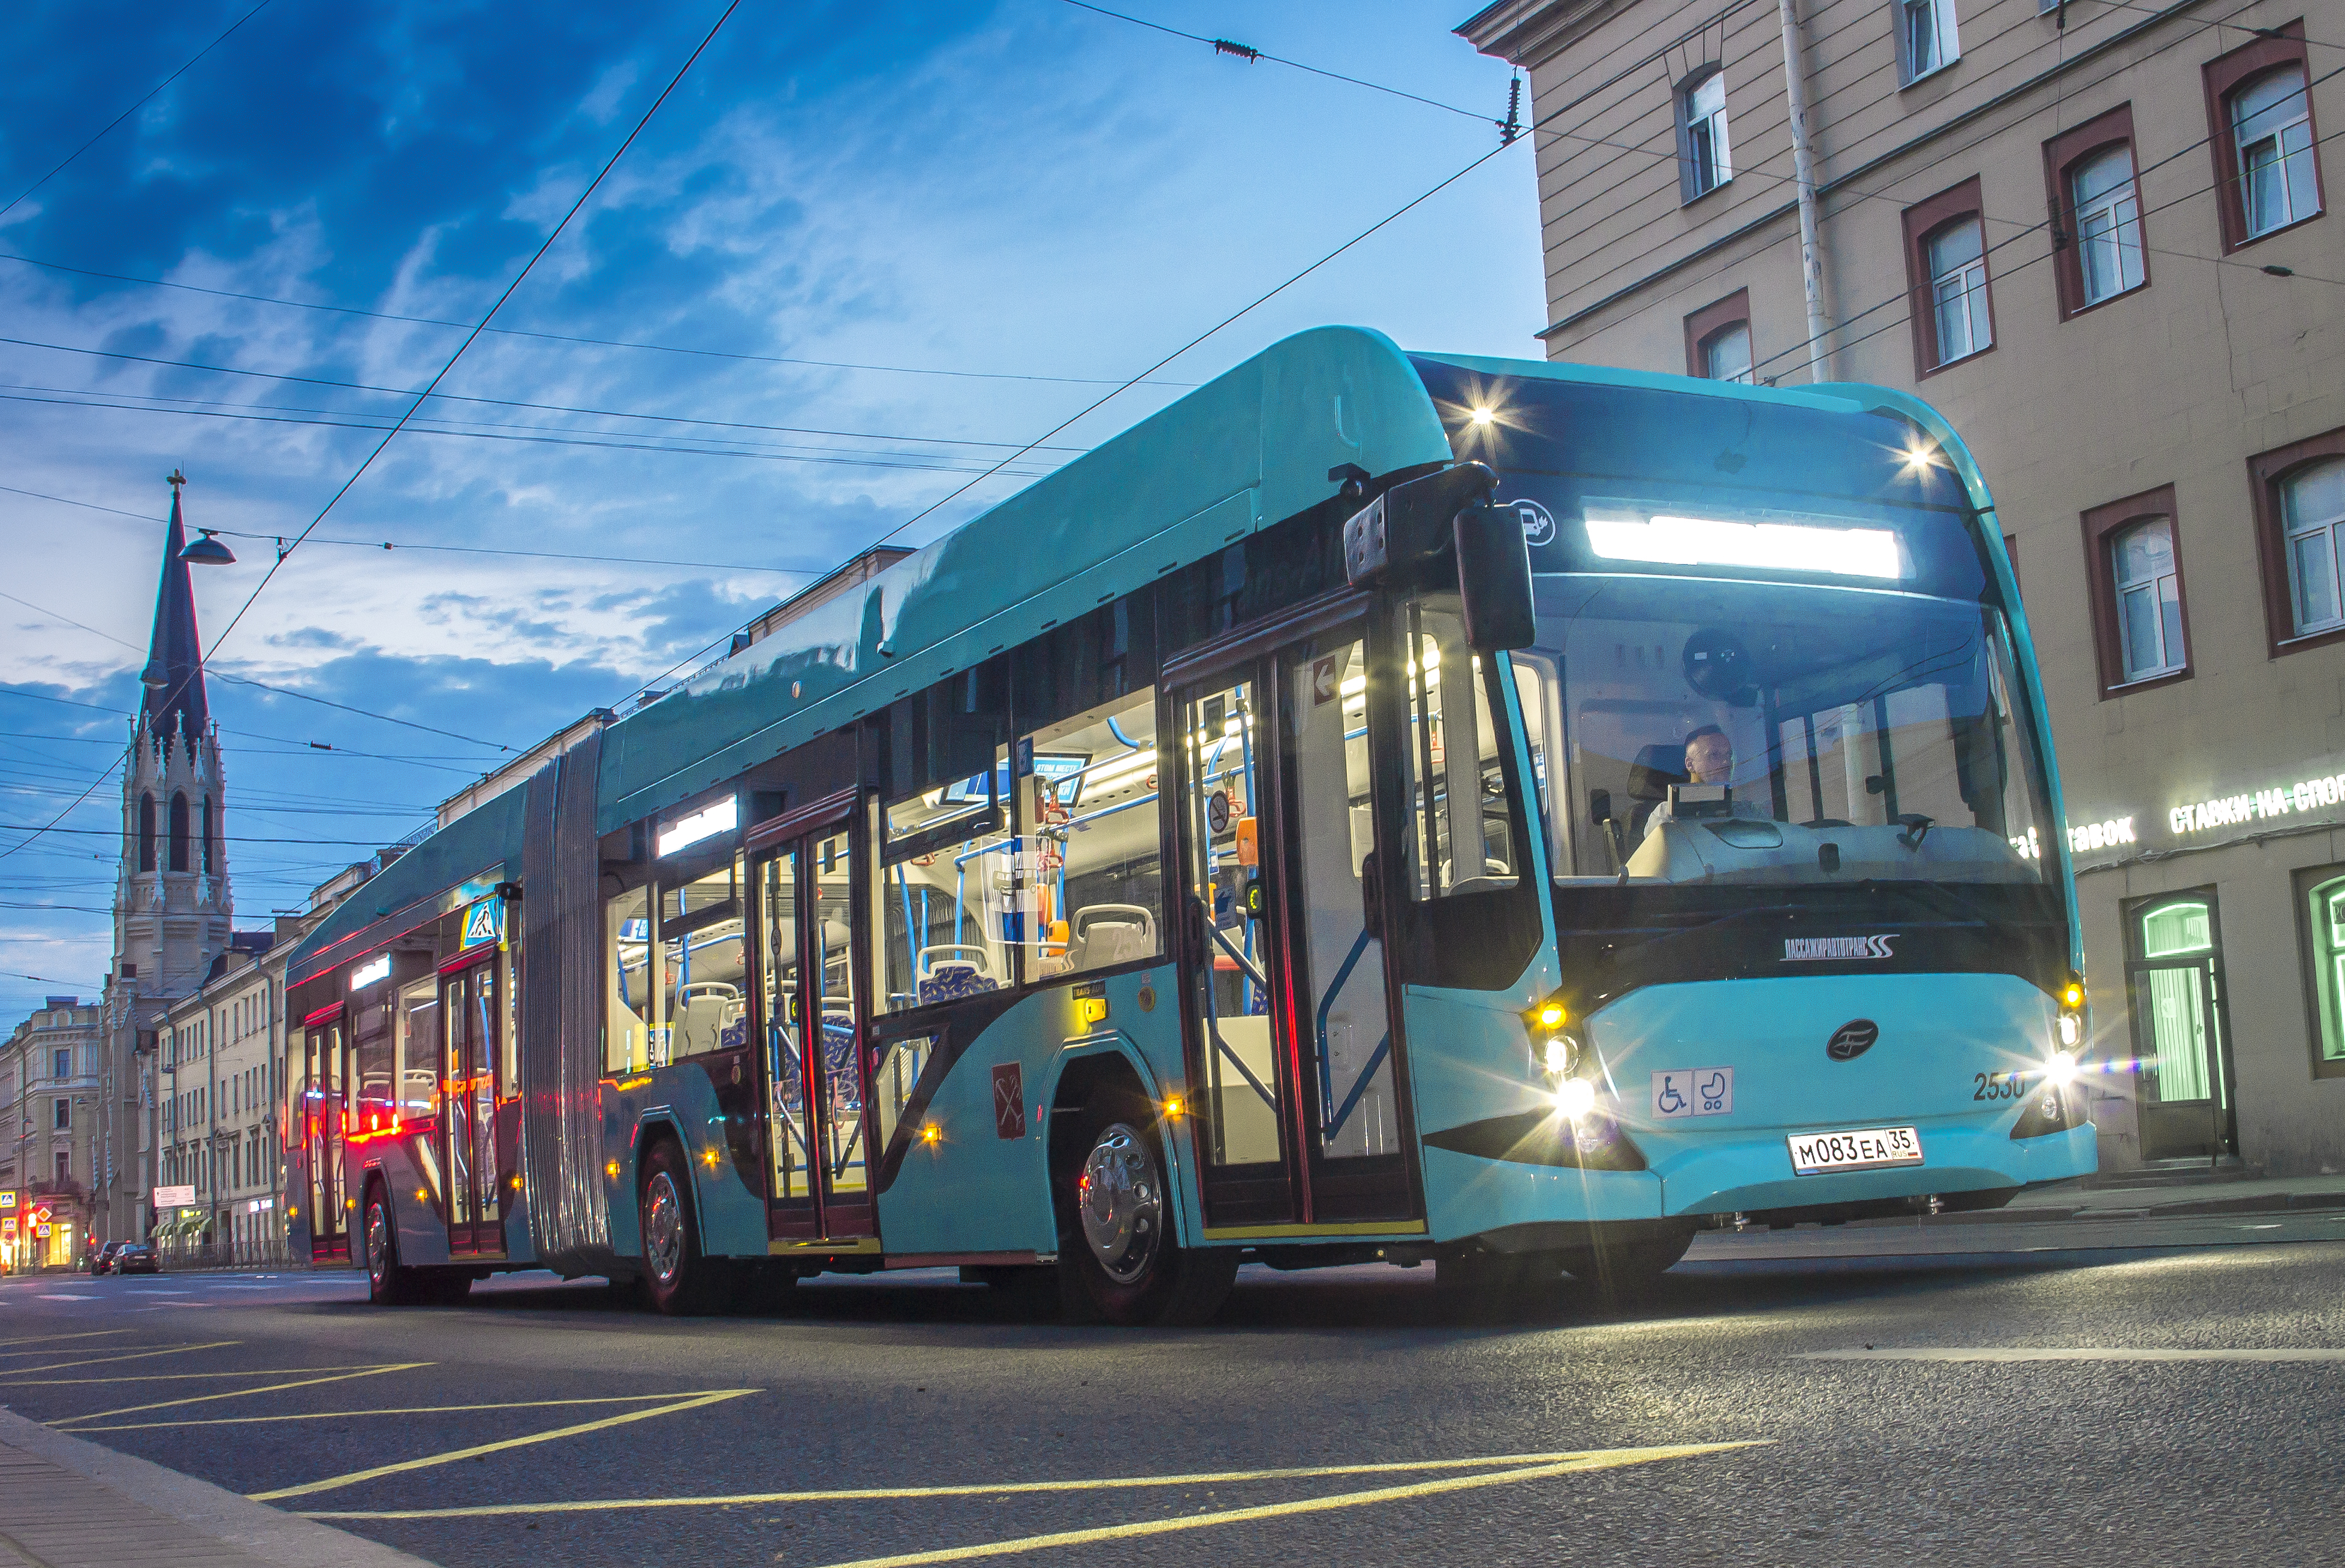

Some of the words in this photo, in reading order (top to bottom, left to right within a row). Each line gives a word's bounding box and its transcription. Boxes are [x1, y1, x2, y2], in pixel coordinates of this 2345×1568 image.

[2170, 794, 2251, 834] СТАВКИ
[2256, 787, 2289, 818] НА
[1785, 937, 1868, 959] ПАССАЖИРАВТОТРАНС
[1973, 1072, 2025, 1100] 2530
[1889, 1130, 1910, 1149] 35
